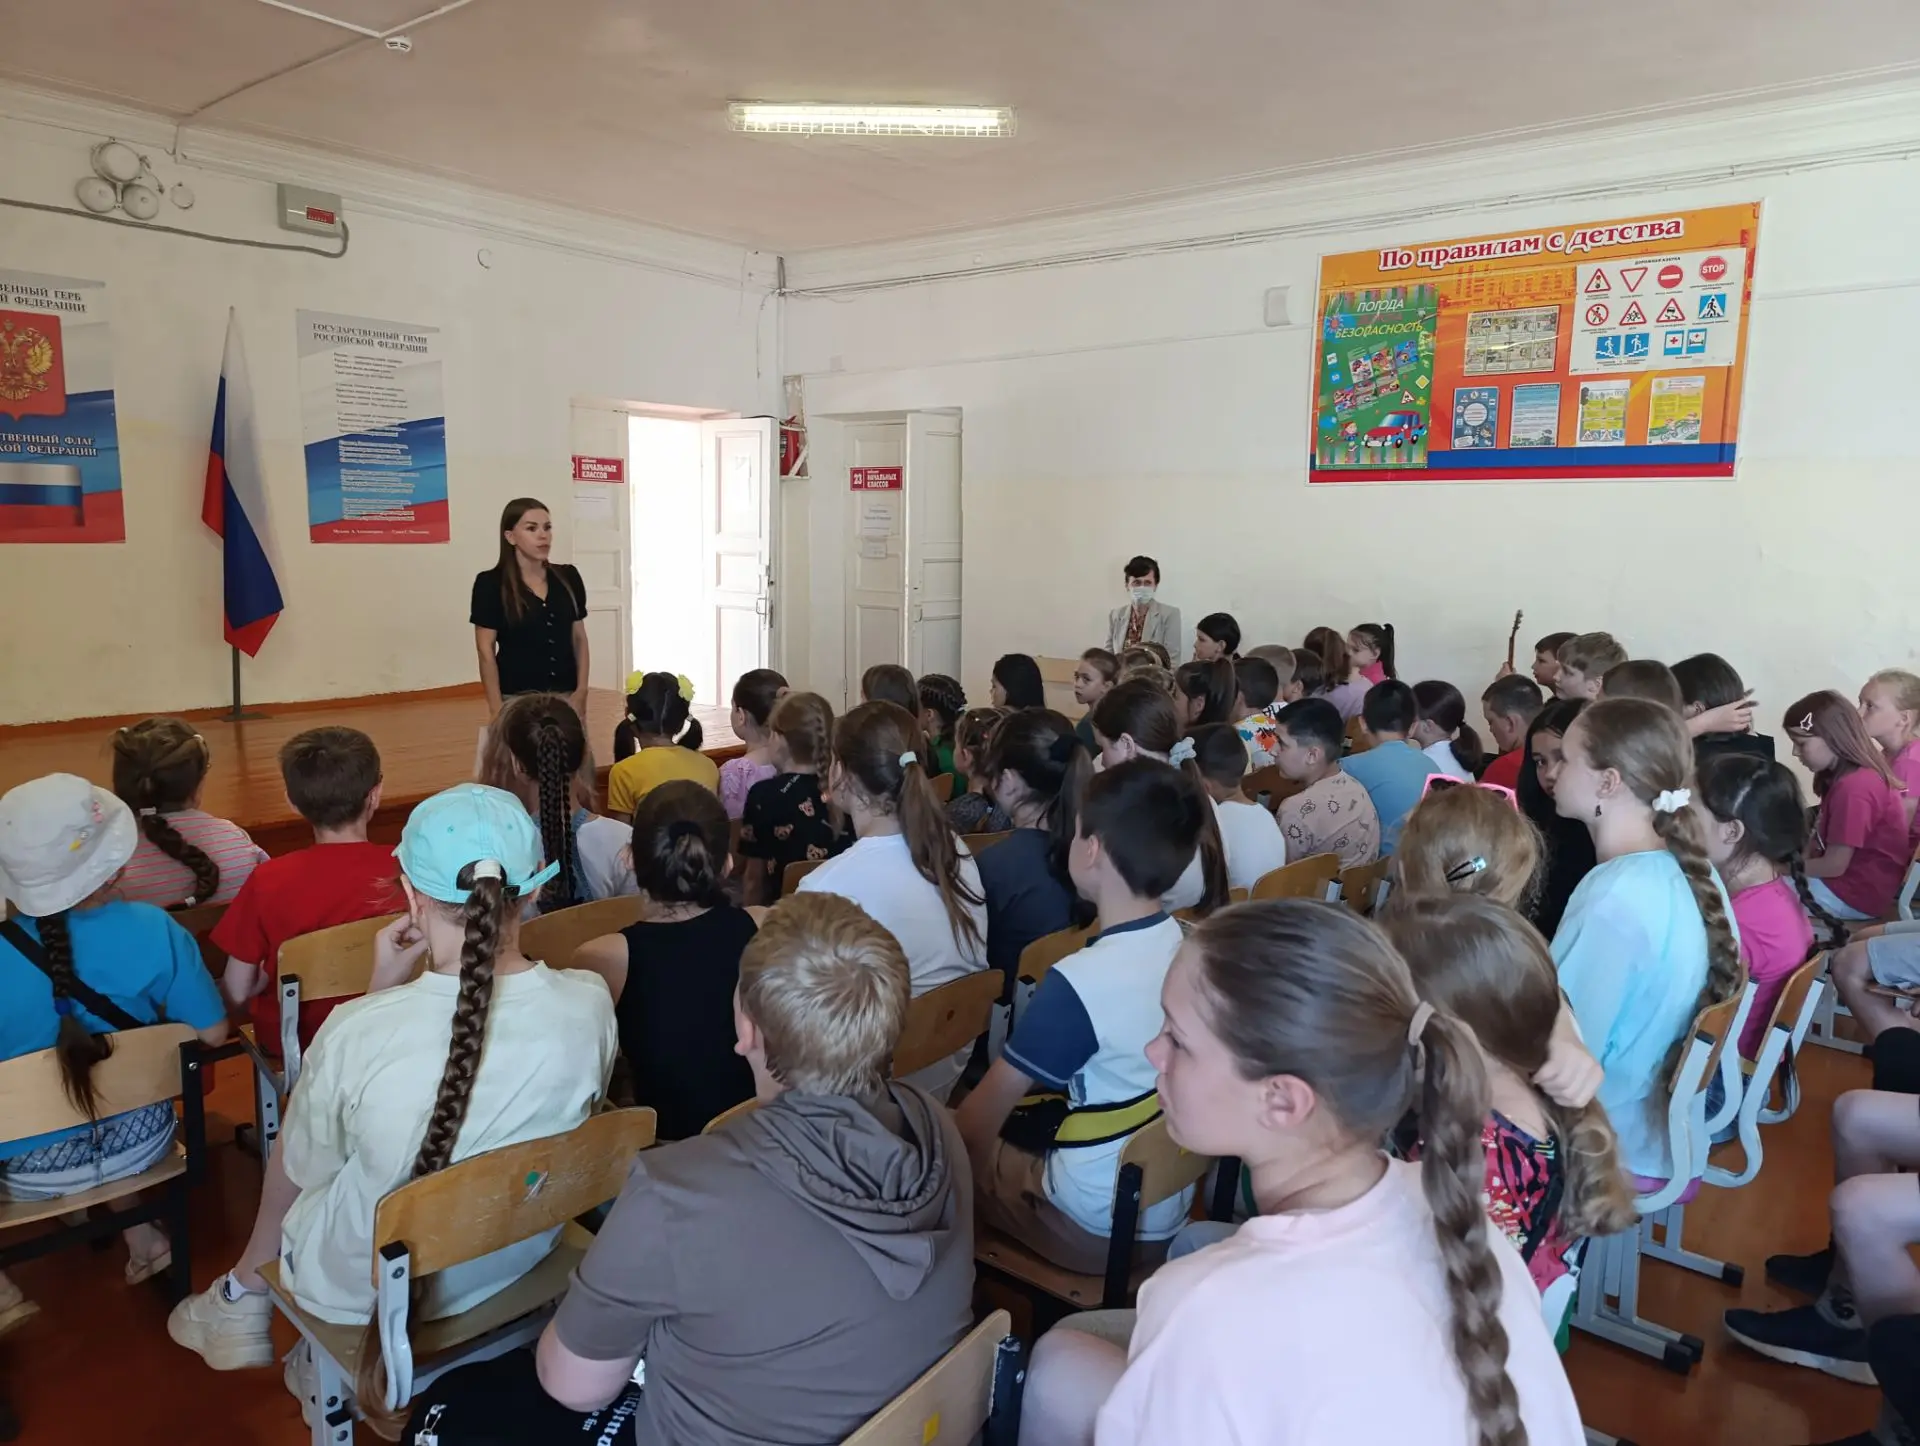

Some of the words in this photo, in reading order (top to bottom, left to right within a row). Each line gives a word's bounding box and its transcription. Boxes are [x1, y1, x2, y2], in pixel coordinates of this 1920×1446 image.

[1382, 250, 1413, 268] По
[1420, 237, 1541, 267] правилам
[1549, 233, 1563, 250] с
[1569, 220, 1682, 251] детства
[1701, 264, 1726, 275] STOP
[54, 289, 82, 302] ГЕРБ
[14, 295, 87, 313] ФЕДЕРАЦИИ
[1357, 298, 1405, 314] ПОГОДА
[312, 322, 400, 341] ГОСУДАРСТВЕННЫЙ
[402, 333, 429, 345] ГИМН
[1335, 320, 1425, 339] БЕЗОПАСНОСТЬ
[313, 331, 375, 347] РОССИЙСКОЙ
[377, 339, 429, 354] ФЕДЕРАЦИИ
[64, 436, 95, 447] ФЛАГ
[26, 444, 98, 457] ФЕДЕРАЦИИ
[582, 463, 618, 473] НАЧАЛЬНЫХ
[582, 470, 608, 479] КЛАССОВ
[853, 473, 863, 485] 23
[867, 473, 897, 482] НАЧАЛЬНЫХ
[867, 480, 889, 488] КЛАССОВ
